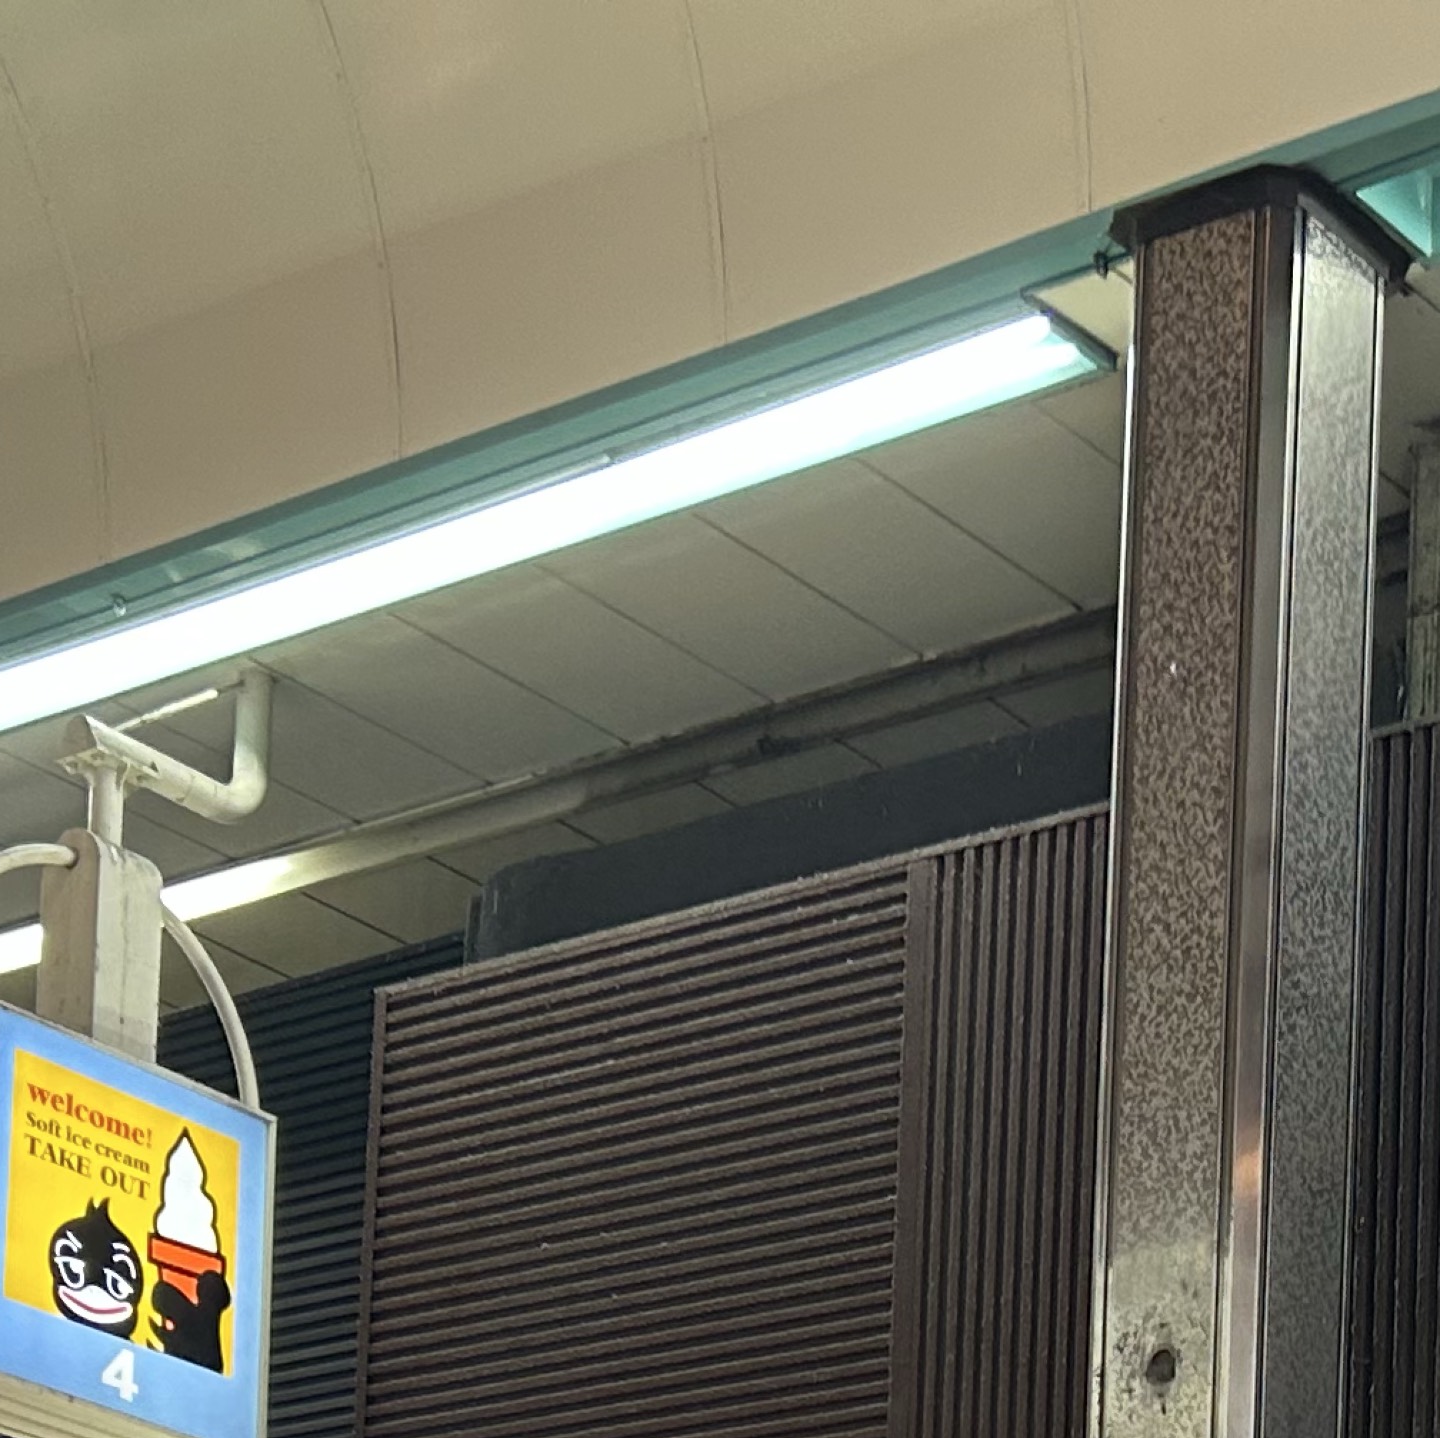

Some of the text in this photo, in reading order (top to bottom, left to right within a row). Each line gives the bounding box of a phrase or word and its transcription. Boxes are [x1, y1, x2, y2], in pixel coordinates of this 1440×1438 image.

[25, 1110, 151, 1175] Soft ice cream
[26, 1082, 153, 1149] welcome!
[23, 1132, 151, 1201] TAKE OUT
[100, 1348, 140, 1401] 4
